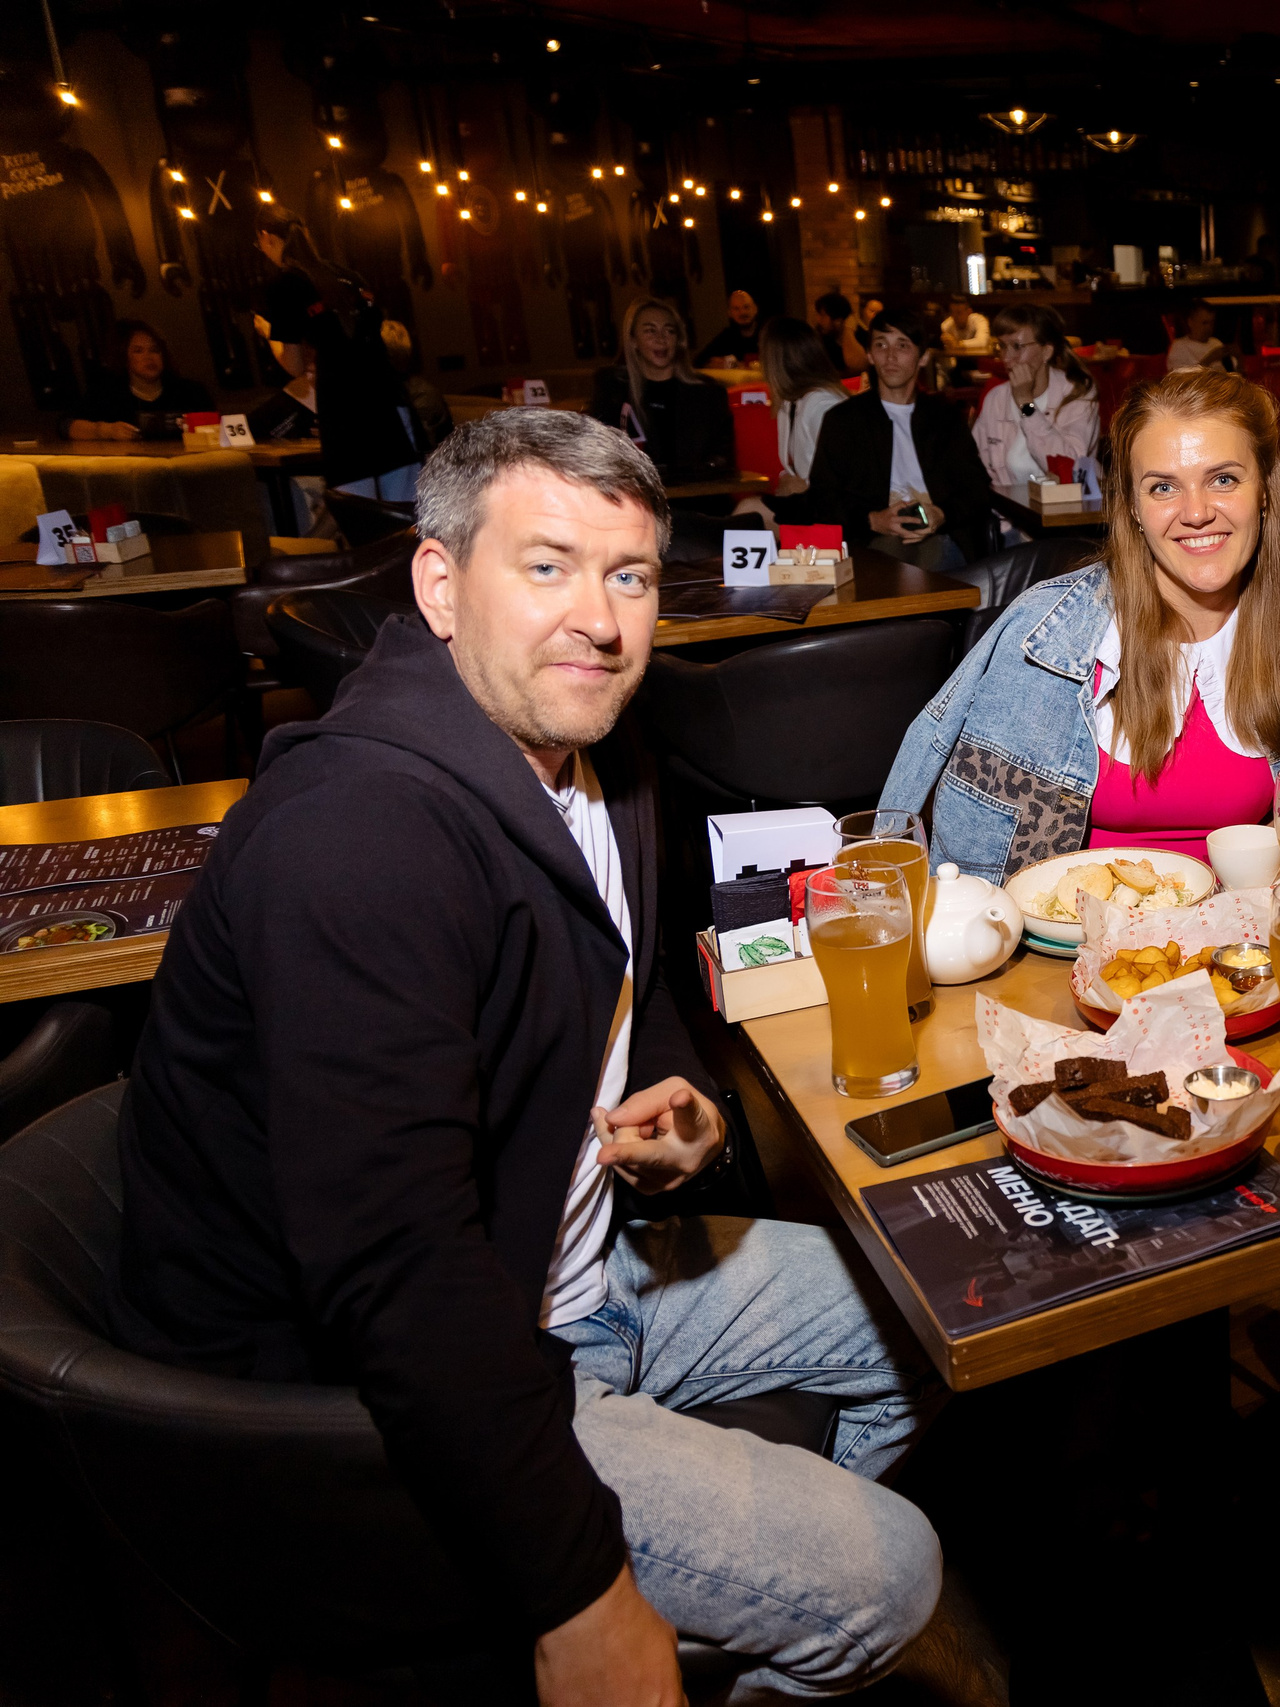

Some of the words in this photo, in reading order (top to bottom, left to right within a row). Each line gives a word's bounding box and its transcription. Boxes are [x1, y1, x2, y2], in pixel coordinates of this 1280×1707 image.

[226, 423, 247, 438] 36
[51, 524, 75, 548] 35
[731, 546, 767, 569] 37
[986, 1165, 1054, 1227] МЕНЮ
